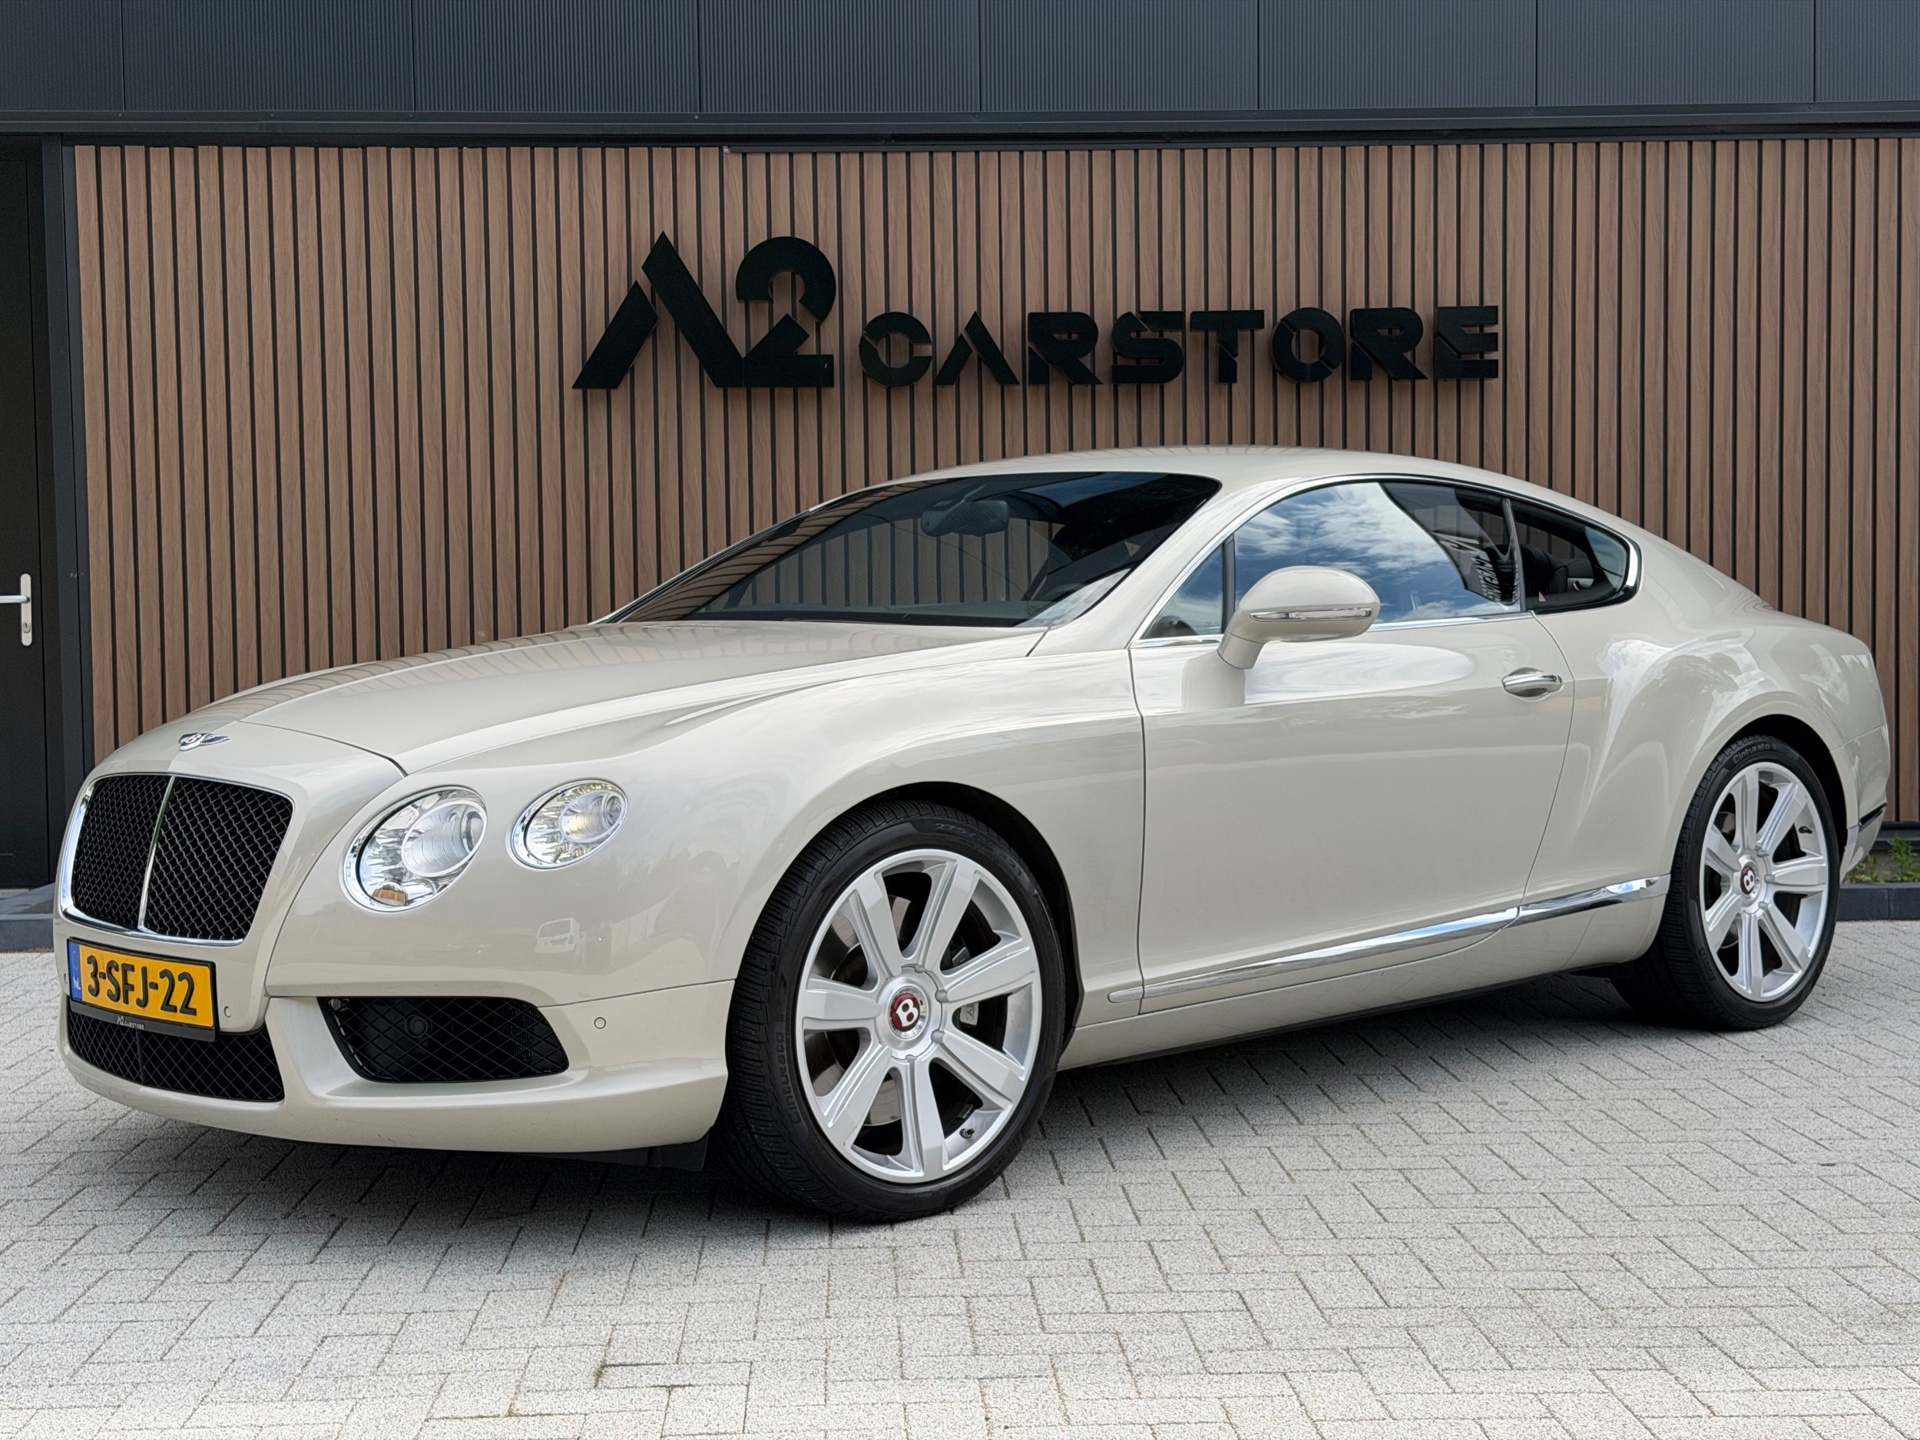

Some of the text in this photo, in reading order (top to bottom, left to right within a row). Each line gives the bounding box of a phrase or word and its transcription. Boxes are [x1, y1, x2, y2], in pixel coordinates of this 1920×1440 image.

[571, 230, 1500, 390] A2 CARSTORE
[86, 954, 198, 1016] 3-SFJ-22
[895, 998, 919, 1028] B
